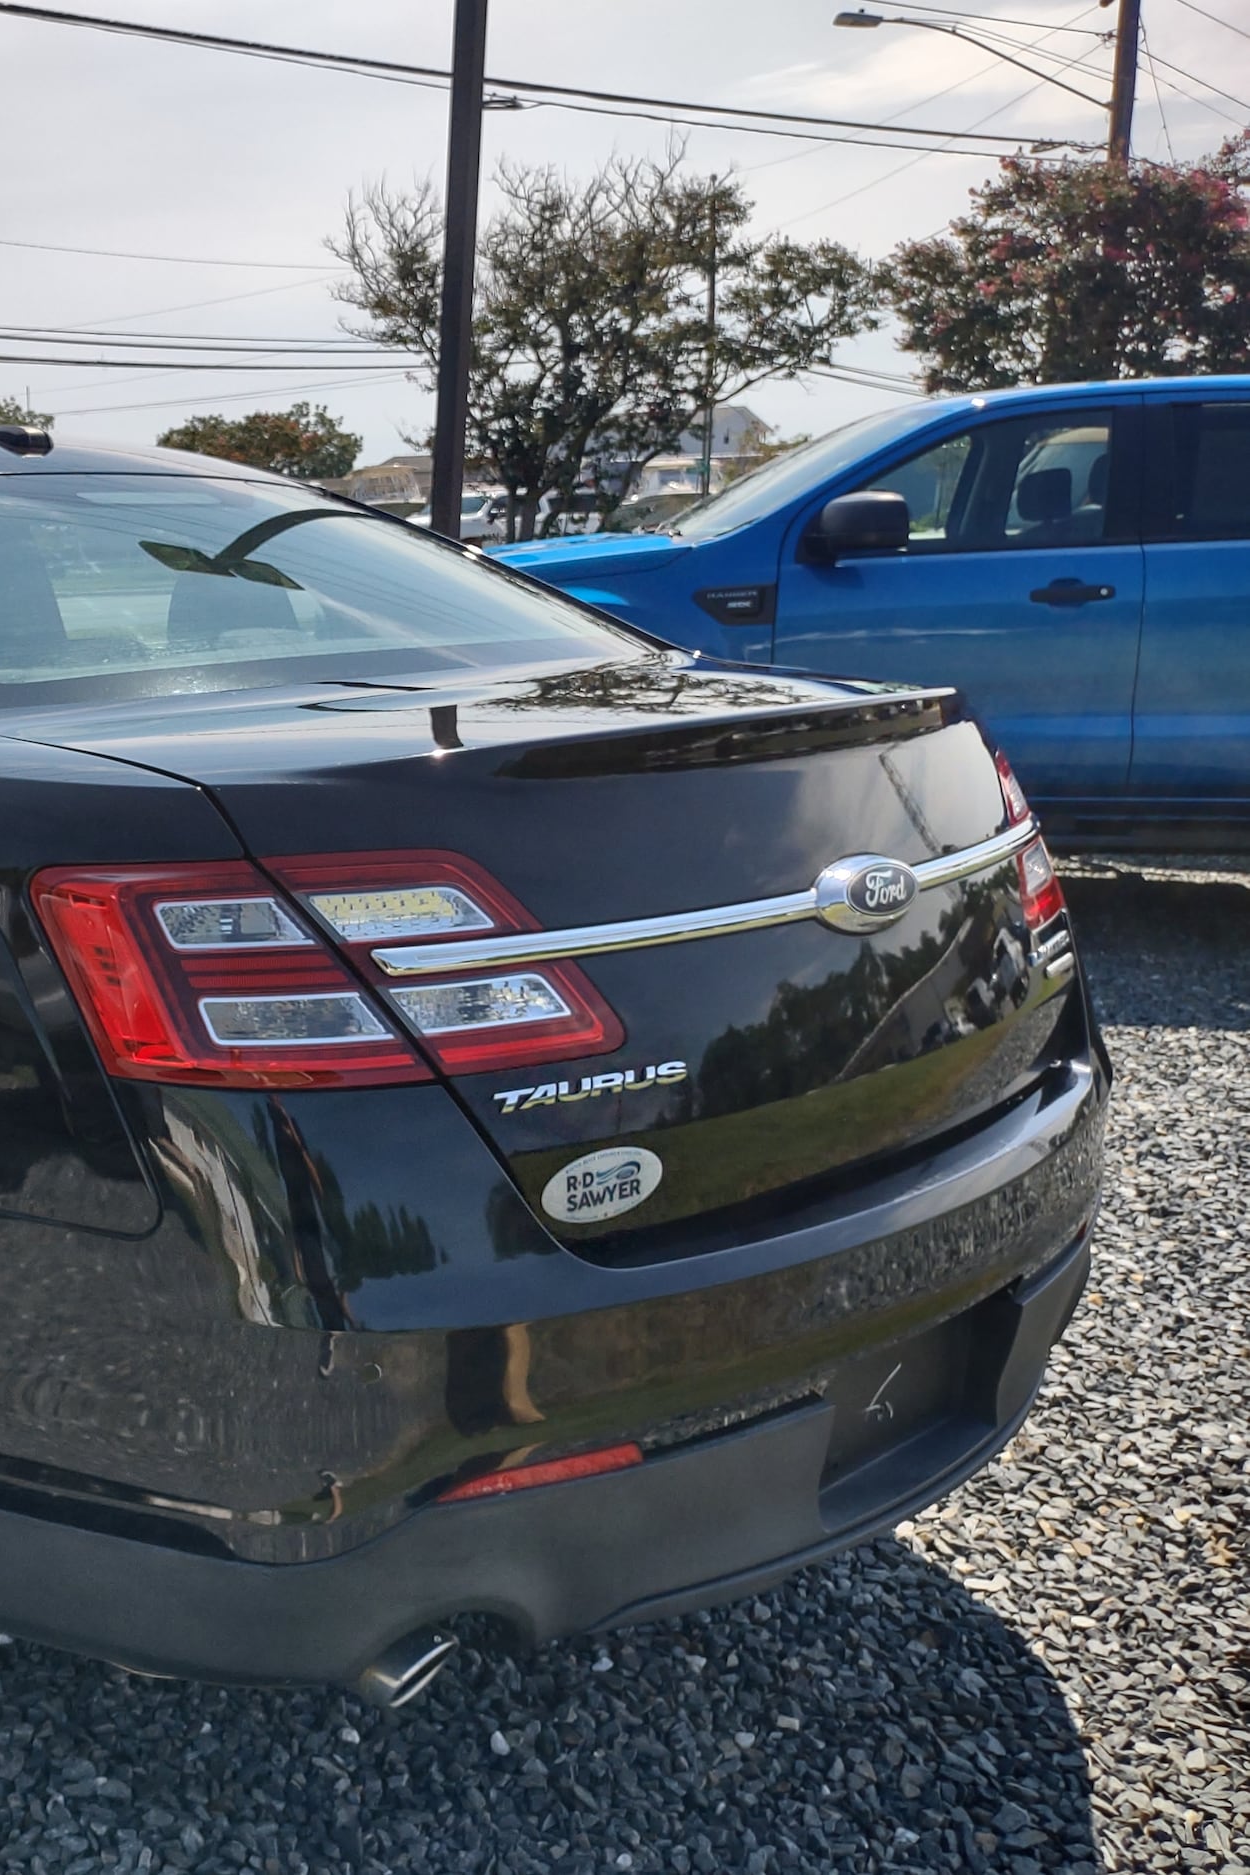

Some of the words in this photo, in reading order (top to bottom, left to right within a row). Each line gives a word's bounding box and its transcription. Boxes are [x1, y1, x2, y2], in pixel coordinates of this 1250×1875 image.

[865, 870, 906, 907] Ford
[493, 1061, 687, 1114] TAURUS
[567, 1179, 641, 1212] SAWYER
